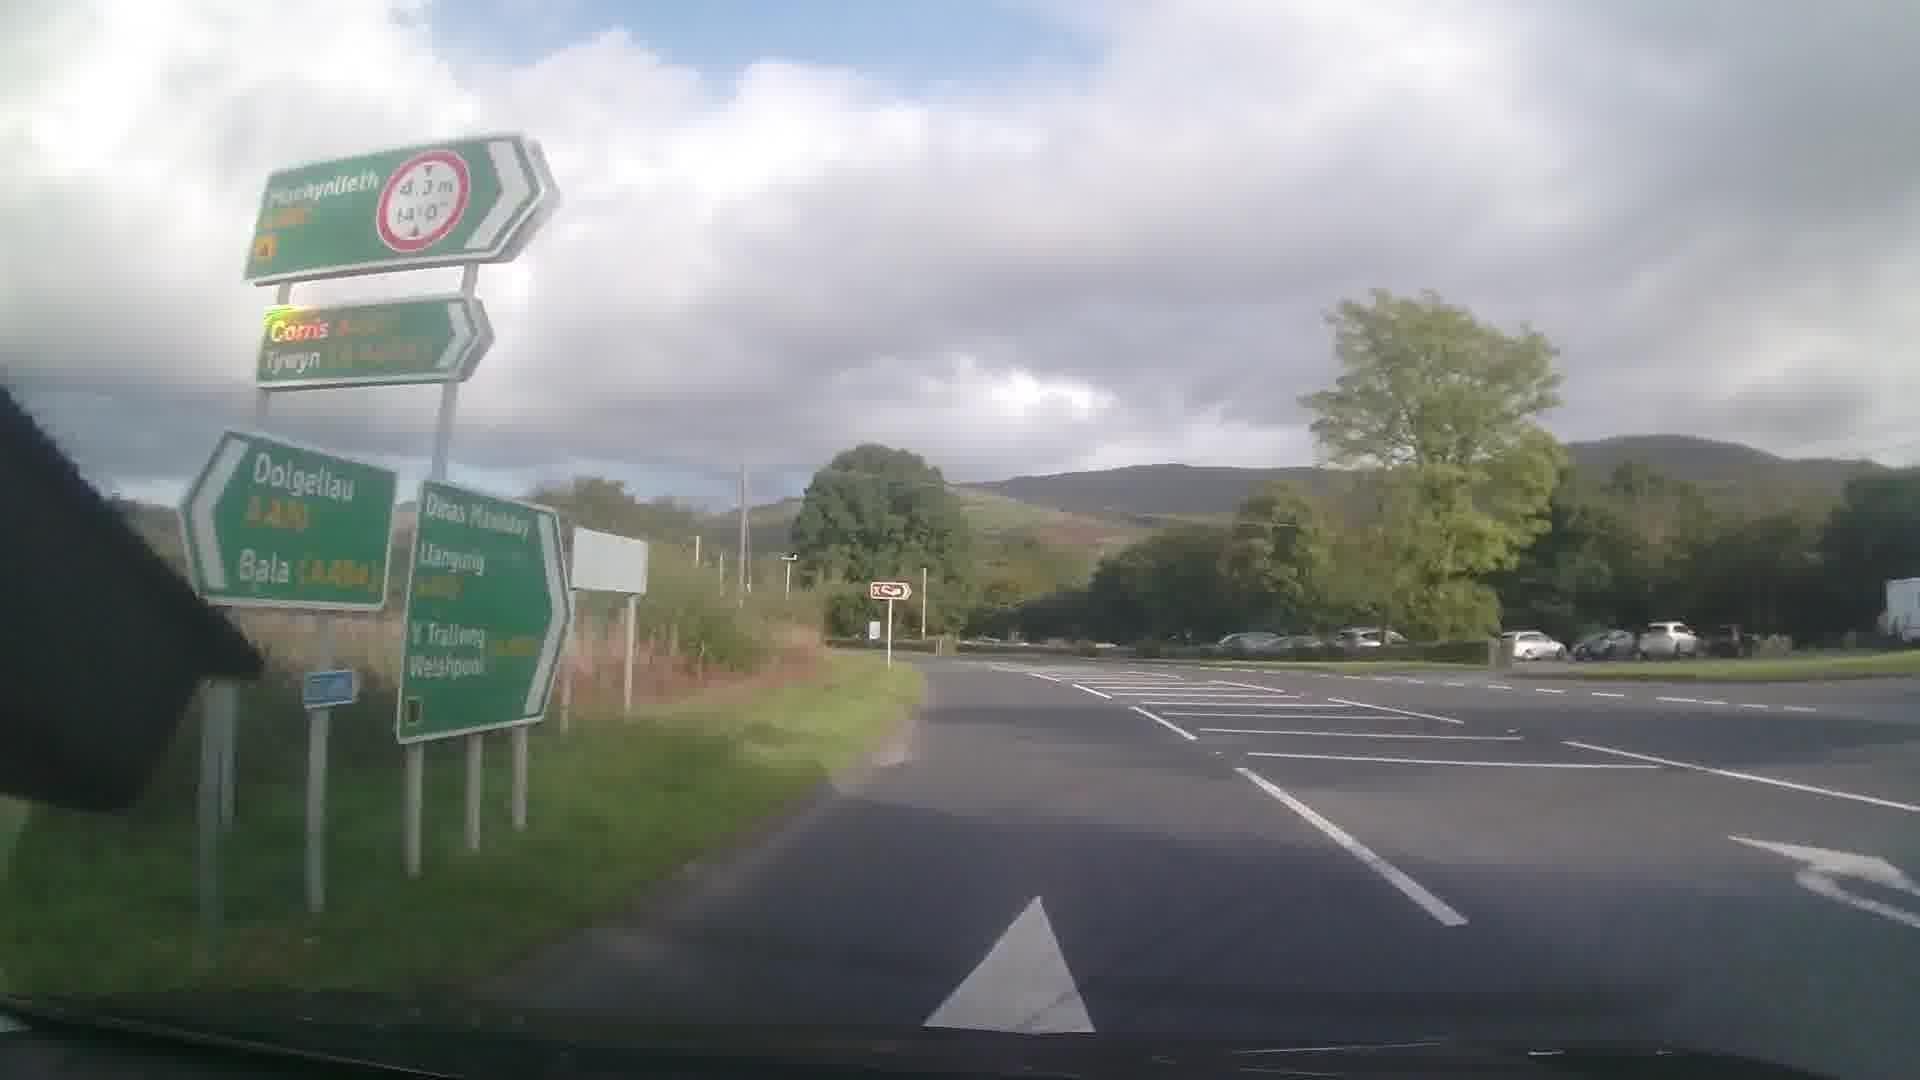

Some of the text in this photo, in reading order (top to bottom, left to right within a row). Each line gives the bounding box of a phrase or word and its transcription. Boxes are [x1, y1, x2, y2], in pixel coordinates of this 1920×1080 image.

[266, 350, 321, 374] Tywyn
[253, 451, 355, 504] Dolgellau
[425, 492, 465, 522] Dinas
[239, 547, 290, 584] Bala
